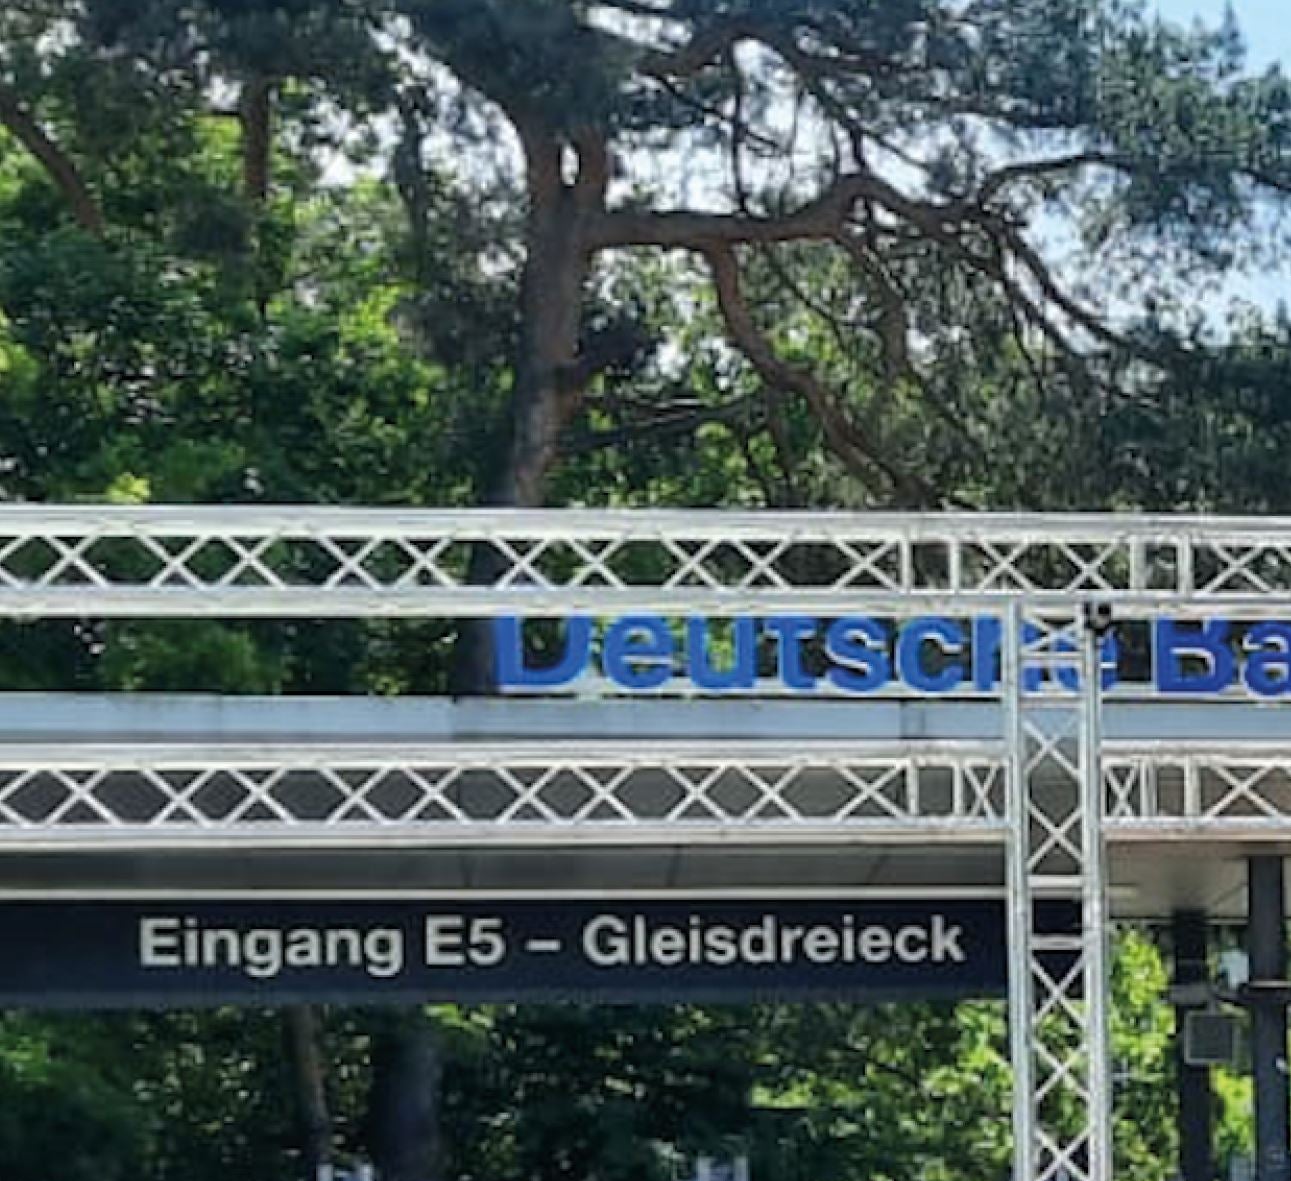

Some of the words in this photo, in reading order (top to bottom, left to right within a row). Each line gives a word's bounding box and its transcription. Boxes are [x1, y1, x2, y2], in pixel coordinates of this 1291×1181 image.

[139, 915, 404, 977] Eingang
[426, 916, 505, 965] E5
[581, 914, 965, 965] Gleisdreieck
